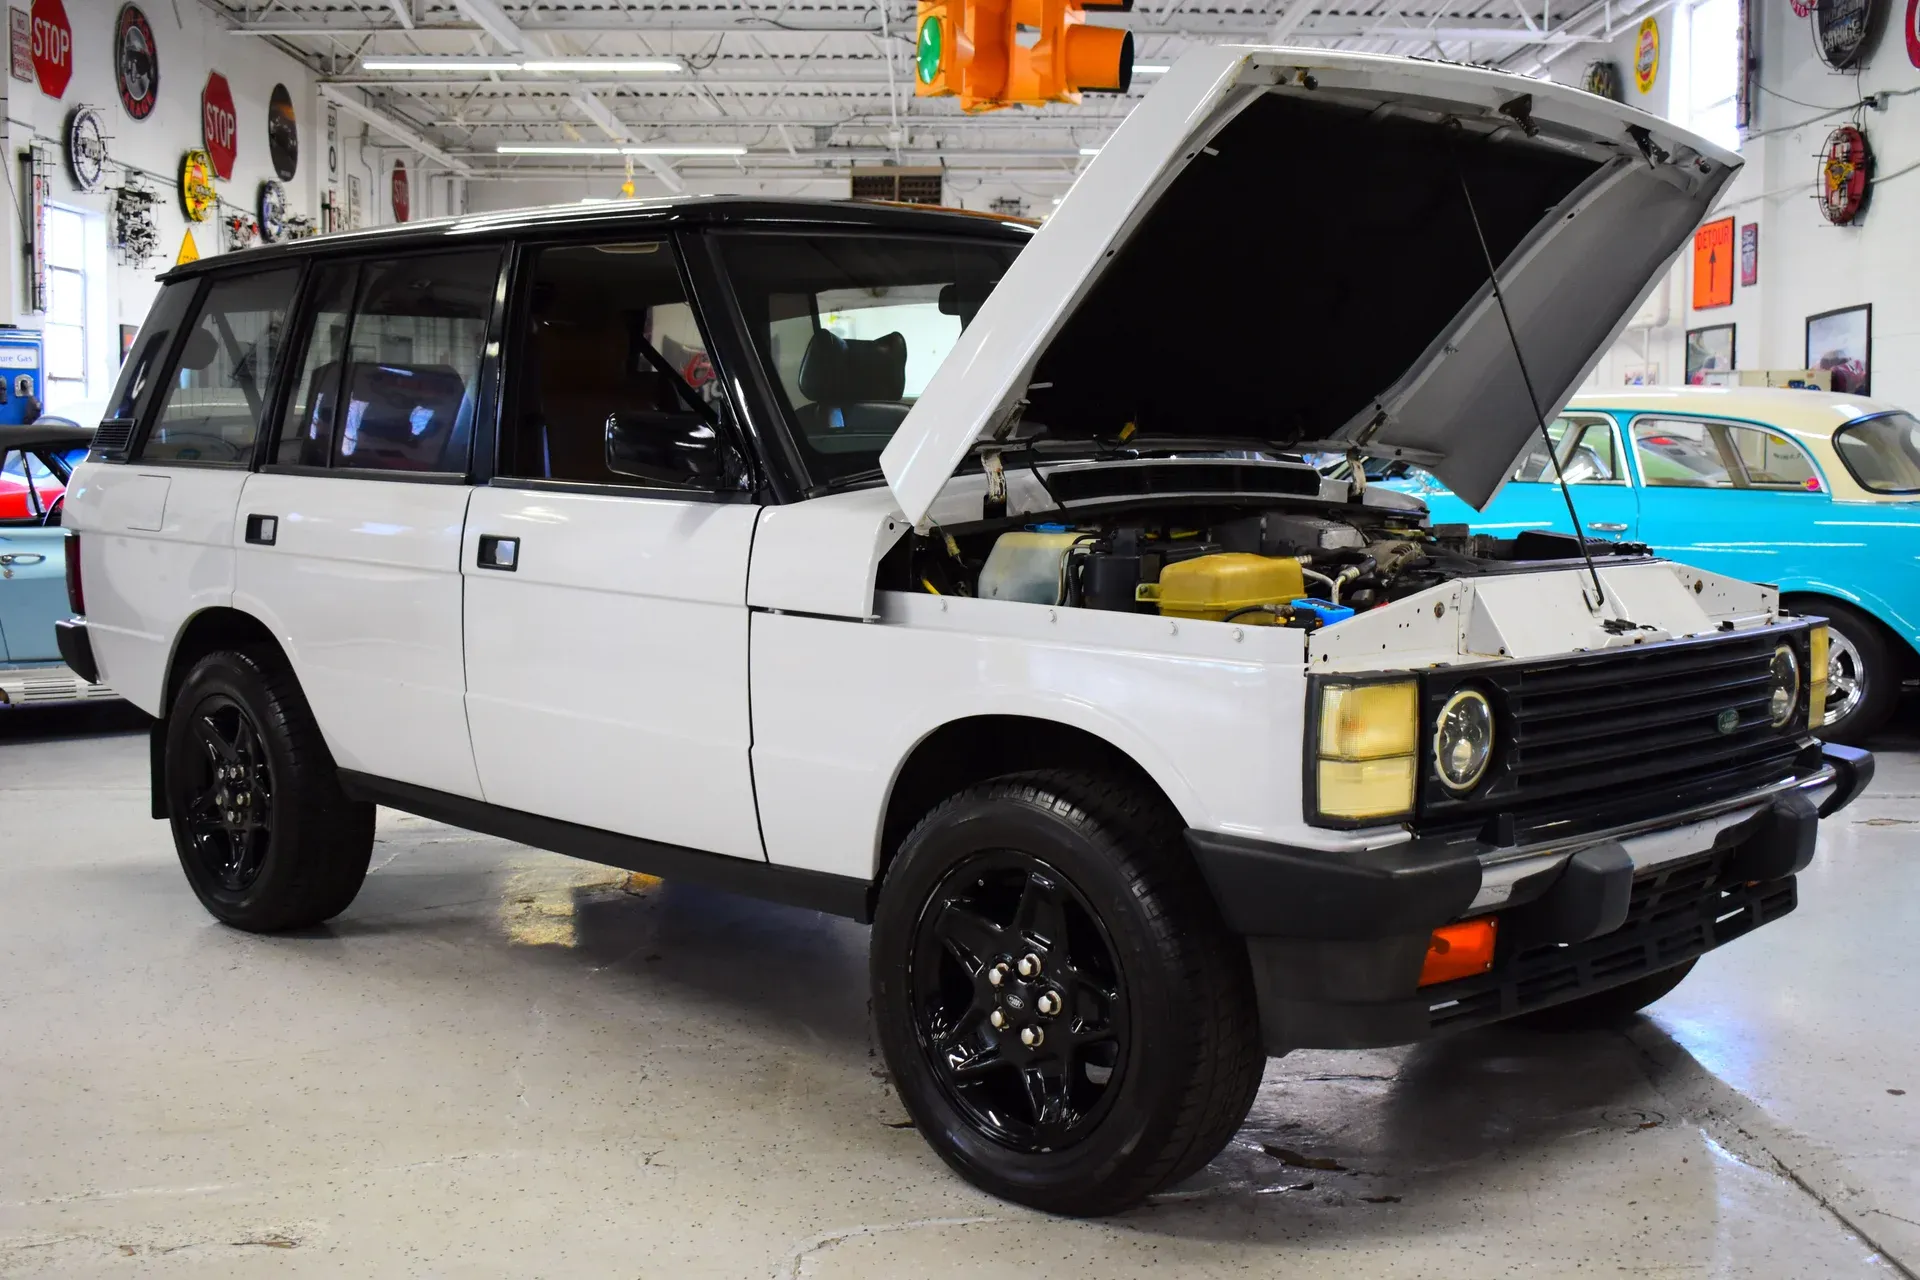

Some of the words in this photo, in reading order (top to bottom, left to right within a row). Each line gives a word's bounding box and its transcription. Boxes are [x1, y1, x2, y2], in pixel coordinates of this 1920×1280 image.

[34, 17, 69, 67] STOP
[1821, 19, 1861, 52] GARAGE
[206, 102, 235, 149] STOP
[1696, 225, 1730, 251] DETOUR
